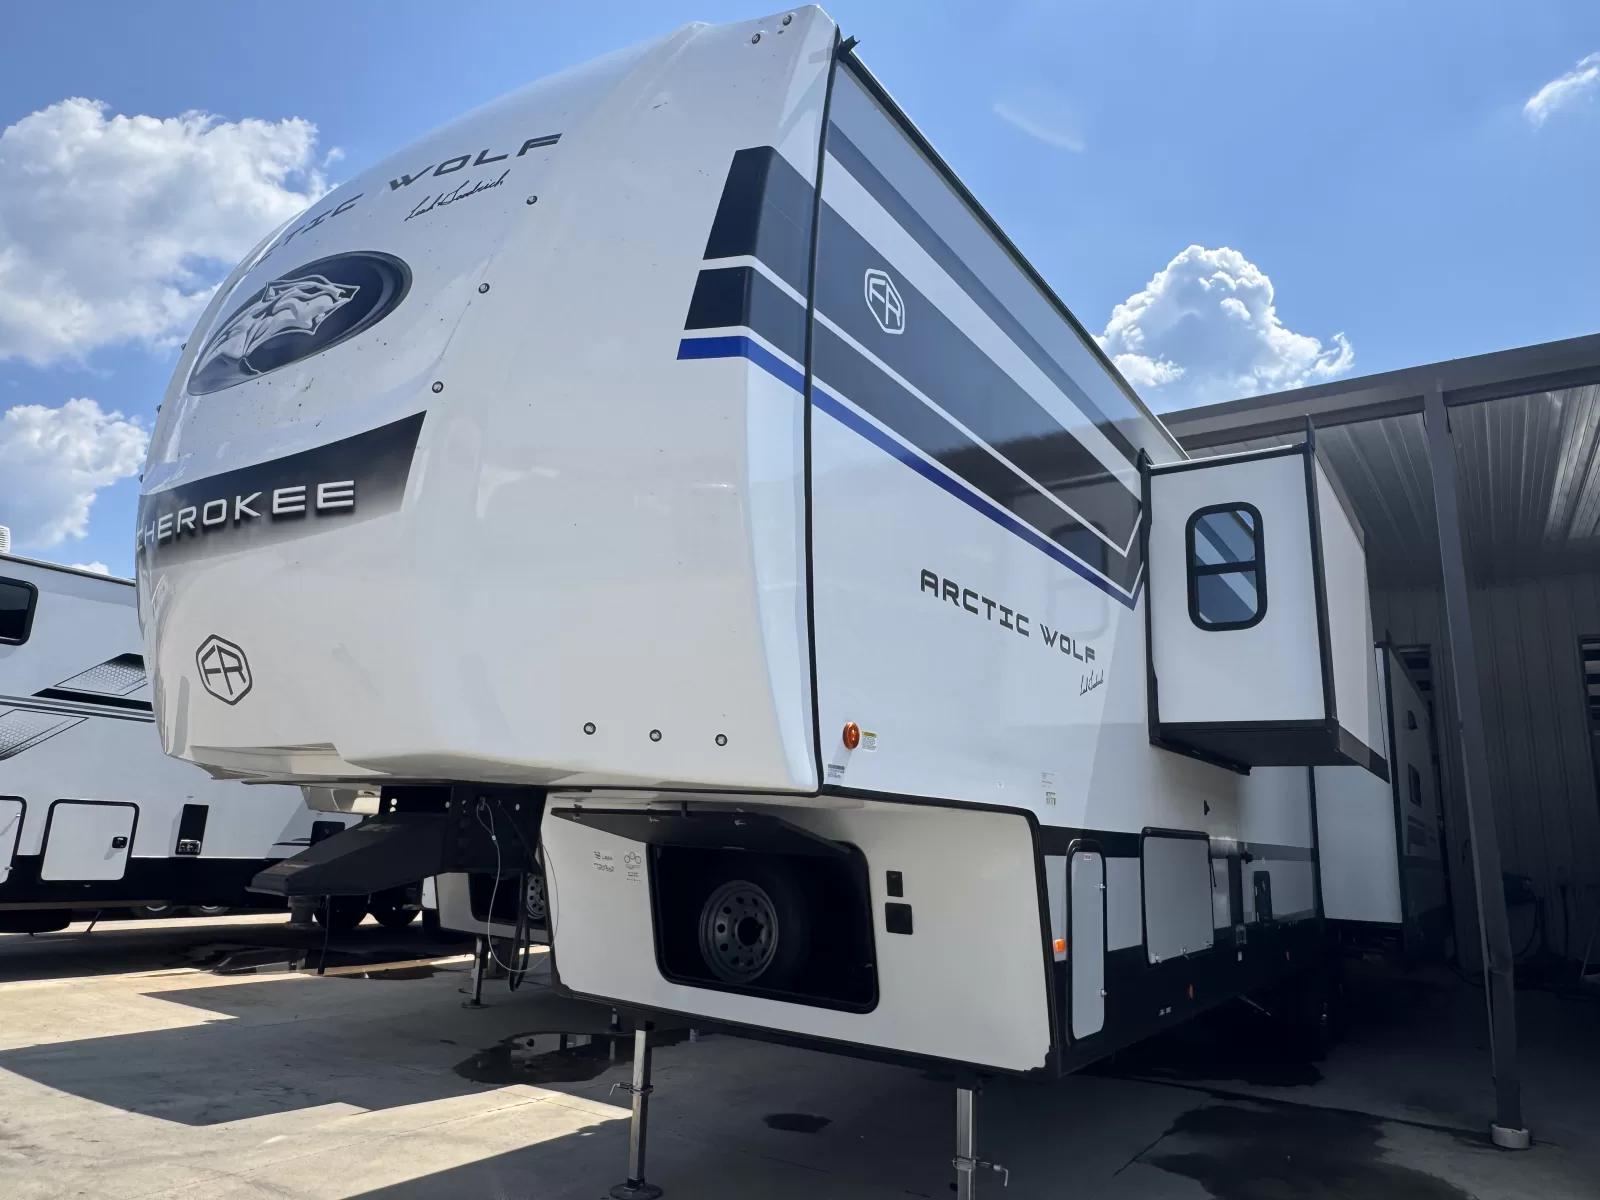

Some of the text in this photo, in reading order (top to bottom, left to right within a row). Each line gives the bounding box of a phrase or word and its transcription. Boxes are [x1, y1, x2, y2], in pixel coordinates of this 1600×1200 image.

[389, 133, 563, 191] WOLF
[136, 480, 355, 551] CHEROKEE
[920, 568, 1096, 664] ARCTIC WOLF
